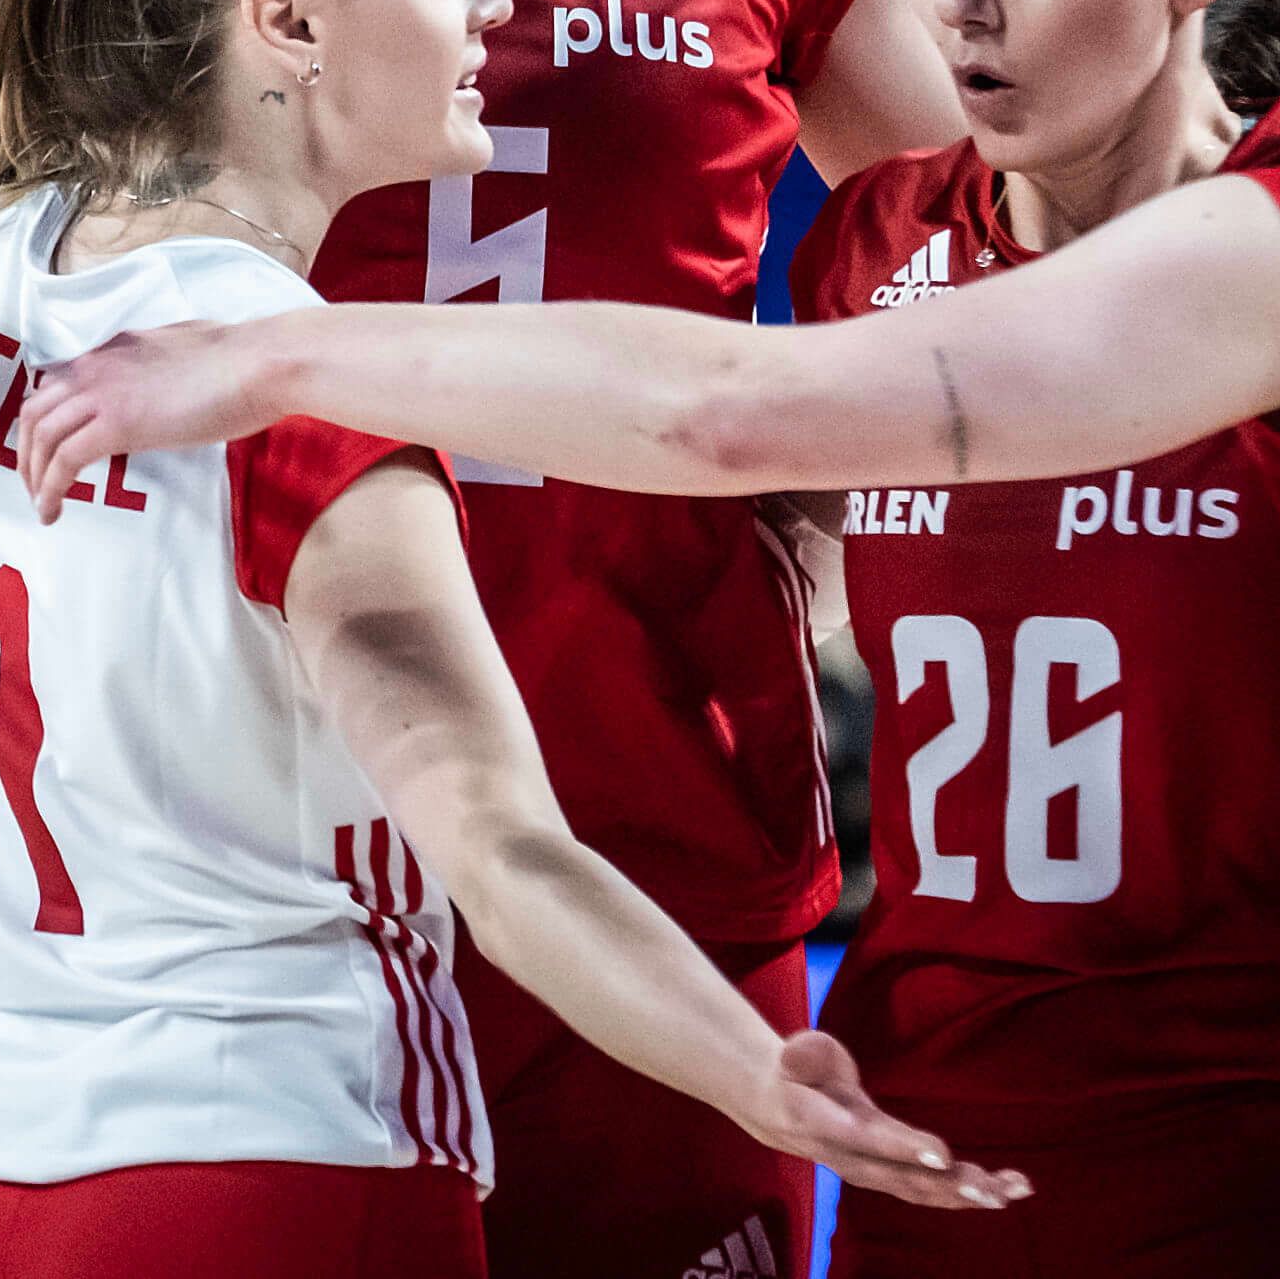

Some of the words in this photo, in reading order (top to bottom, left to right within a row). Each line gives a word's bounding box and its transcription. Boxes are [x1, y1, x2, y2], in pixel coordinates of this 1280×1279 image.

[842, 489, 950, 535] RLEN
[1056, 470, 1240, 551] plus
[891, 615, 1123, 903] 26
